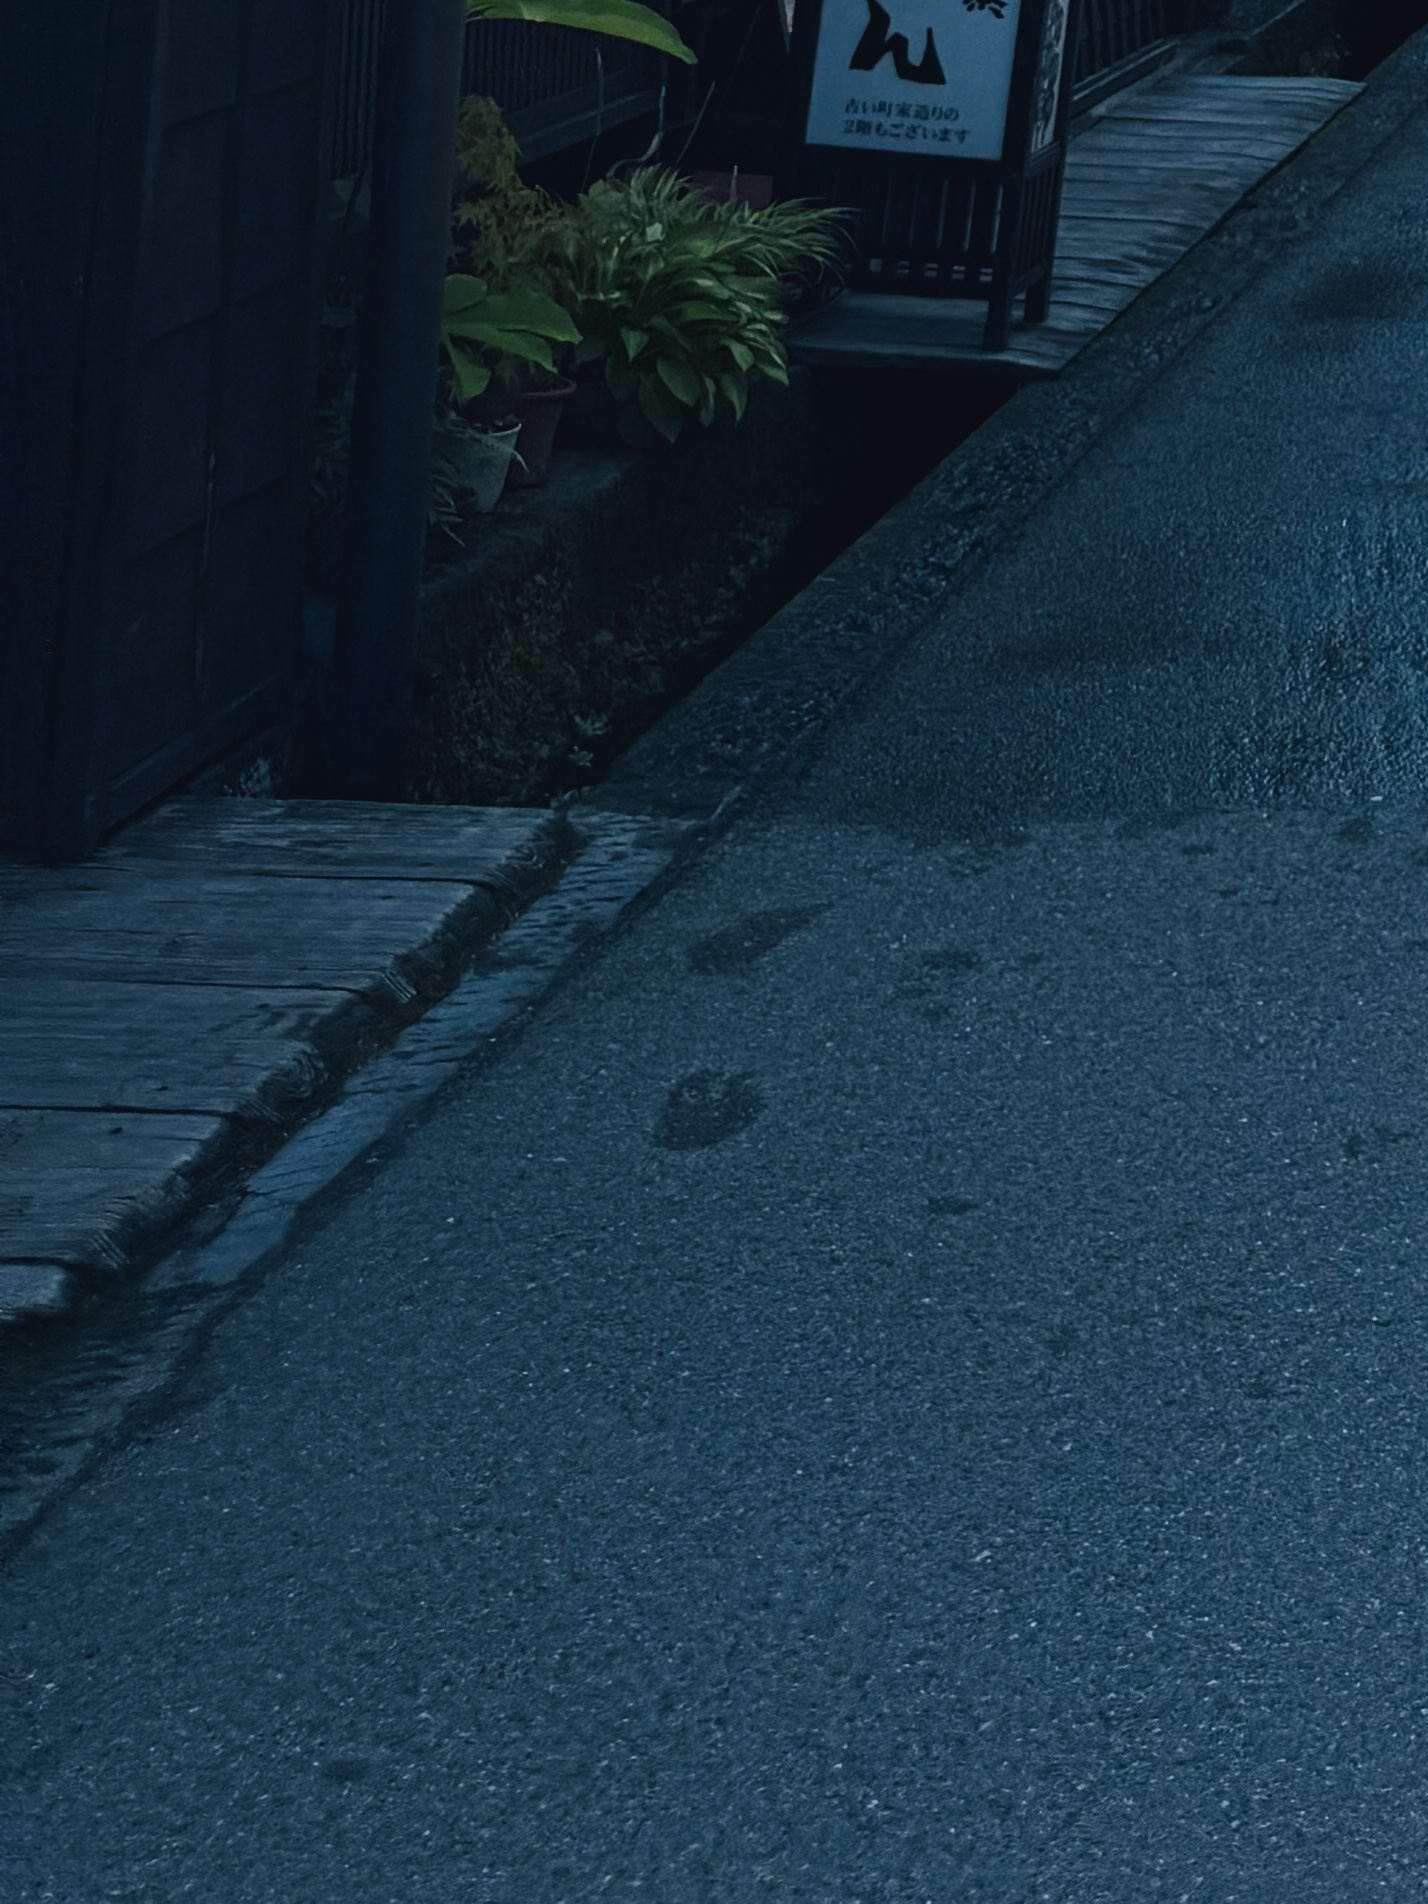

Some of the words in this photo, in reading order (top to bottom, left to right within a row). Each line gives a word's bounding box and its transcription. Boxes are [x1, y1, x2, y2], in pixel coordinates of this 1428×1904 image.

[845, 97, 960, 122] 古い町家造りの
[843, 119, 971, 143] 2階もございます
